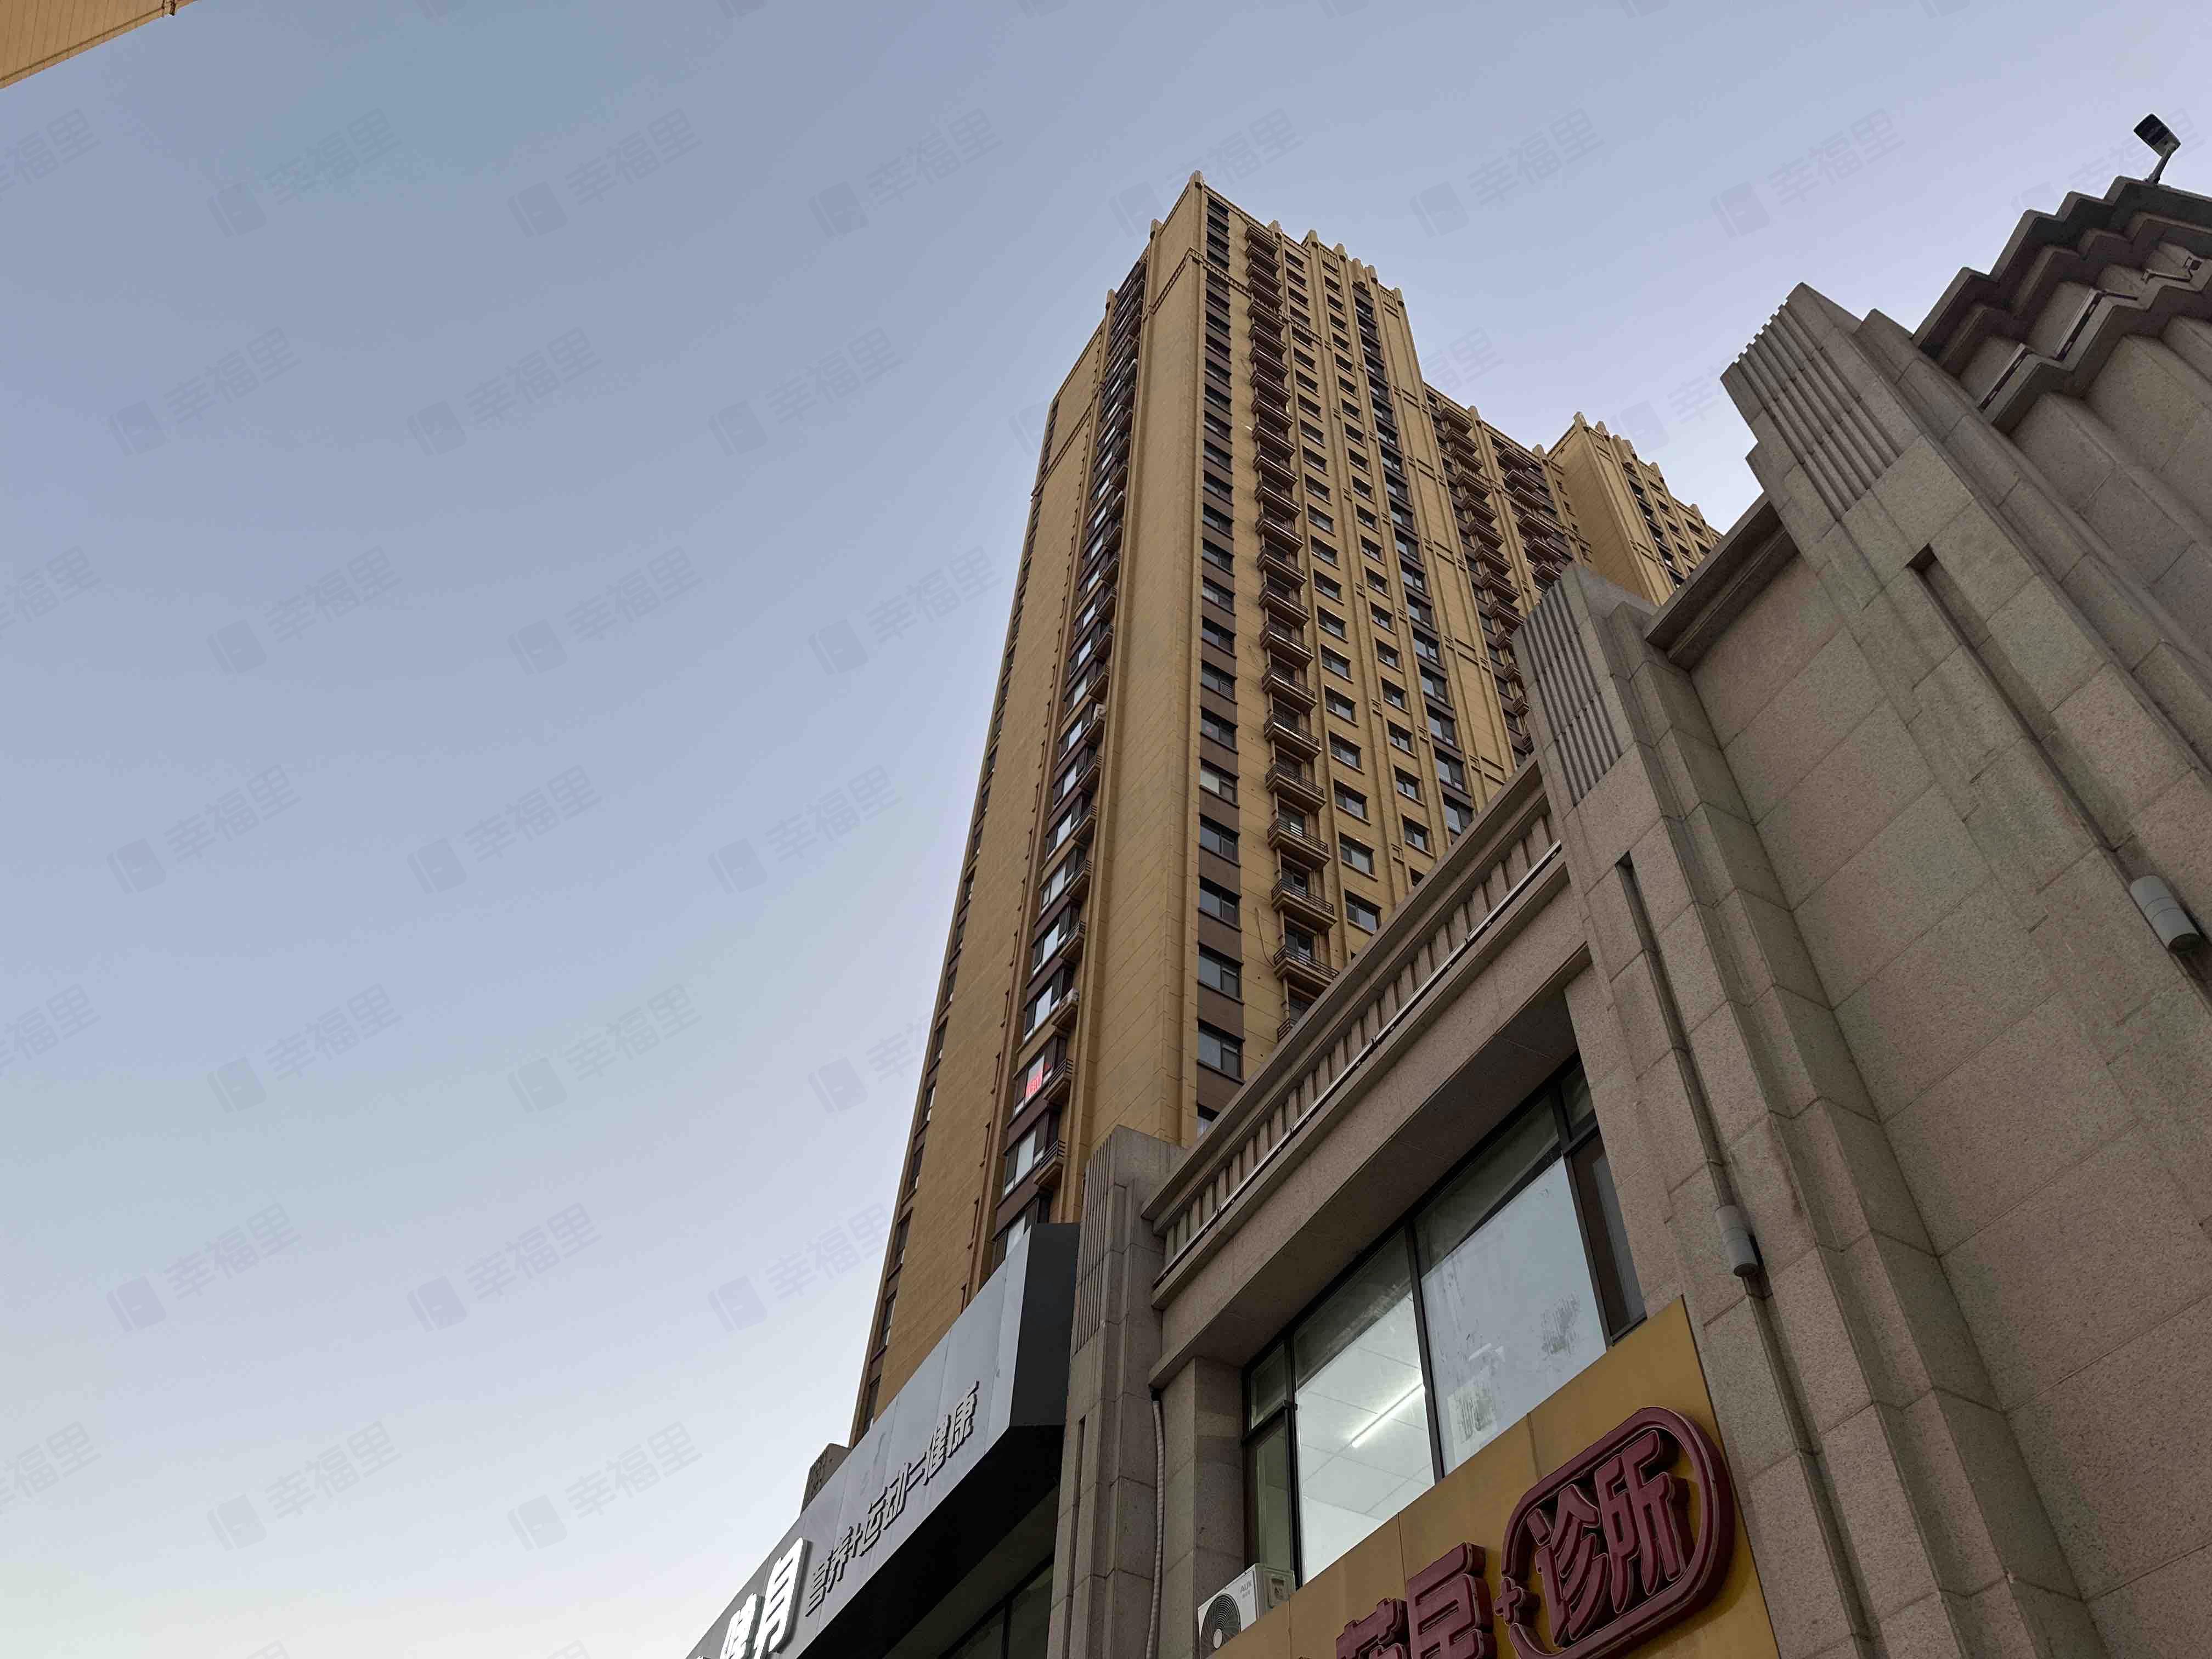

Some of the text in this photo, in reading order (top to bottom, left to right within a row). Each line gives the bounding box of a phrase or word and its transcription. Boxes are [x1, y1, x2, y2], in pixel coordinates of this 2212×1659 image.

[700, 1537, 804, 1659] 健身
[1240, 1581, 1252, 1593] AUX
[1527, 1430, 1682, 1646] 诊所
